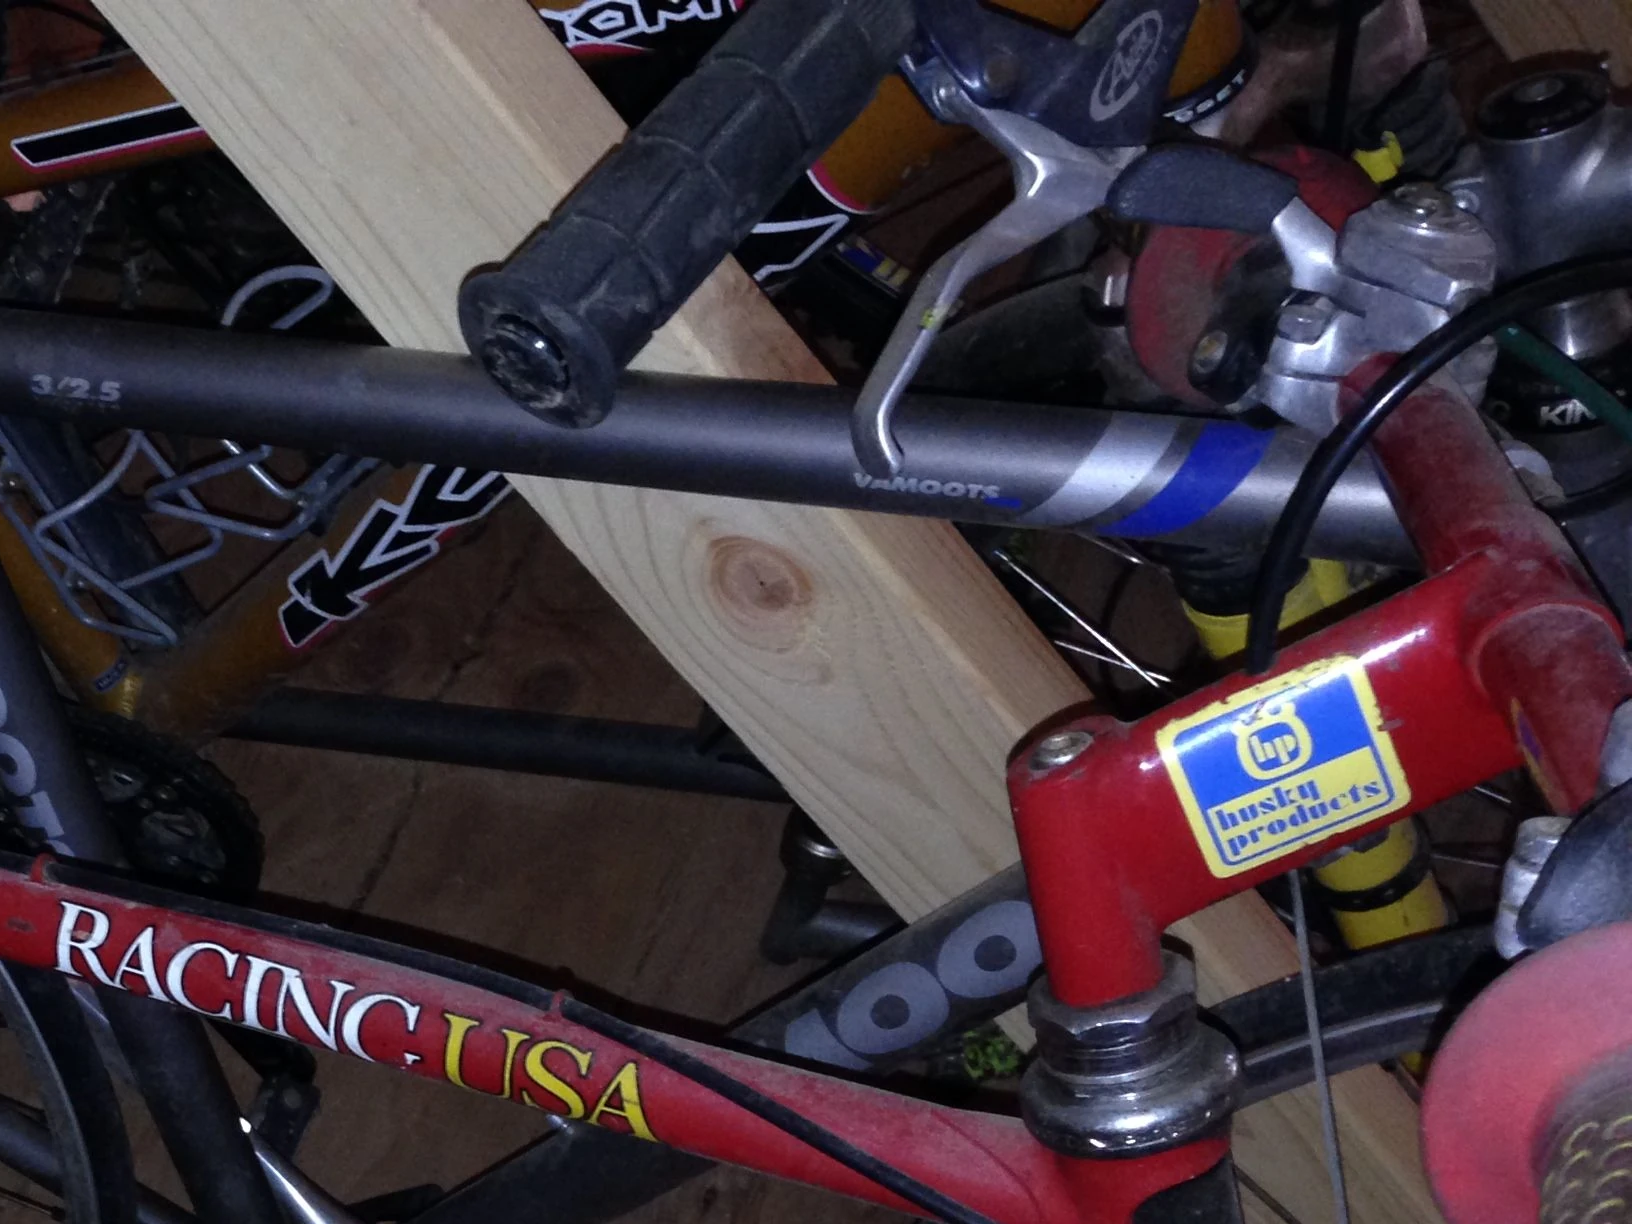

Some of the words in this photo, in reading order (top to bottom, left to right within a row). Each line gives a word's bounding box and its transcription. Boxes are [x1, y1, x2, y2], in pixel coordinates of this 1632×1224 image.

[30, 373, 121, 402] 3/2.5
[1539, 398, 1598, 427] KIN
[1215, 780, 1321, 831] husky
[1226, 781, 1382, 857] products
[52, 900, 422, 1070] RACING
[442, 1012, 661, 1143] USA
